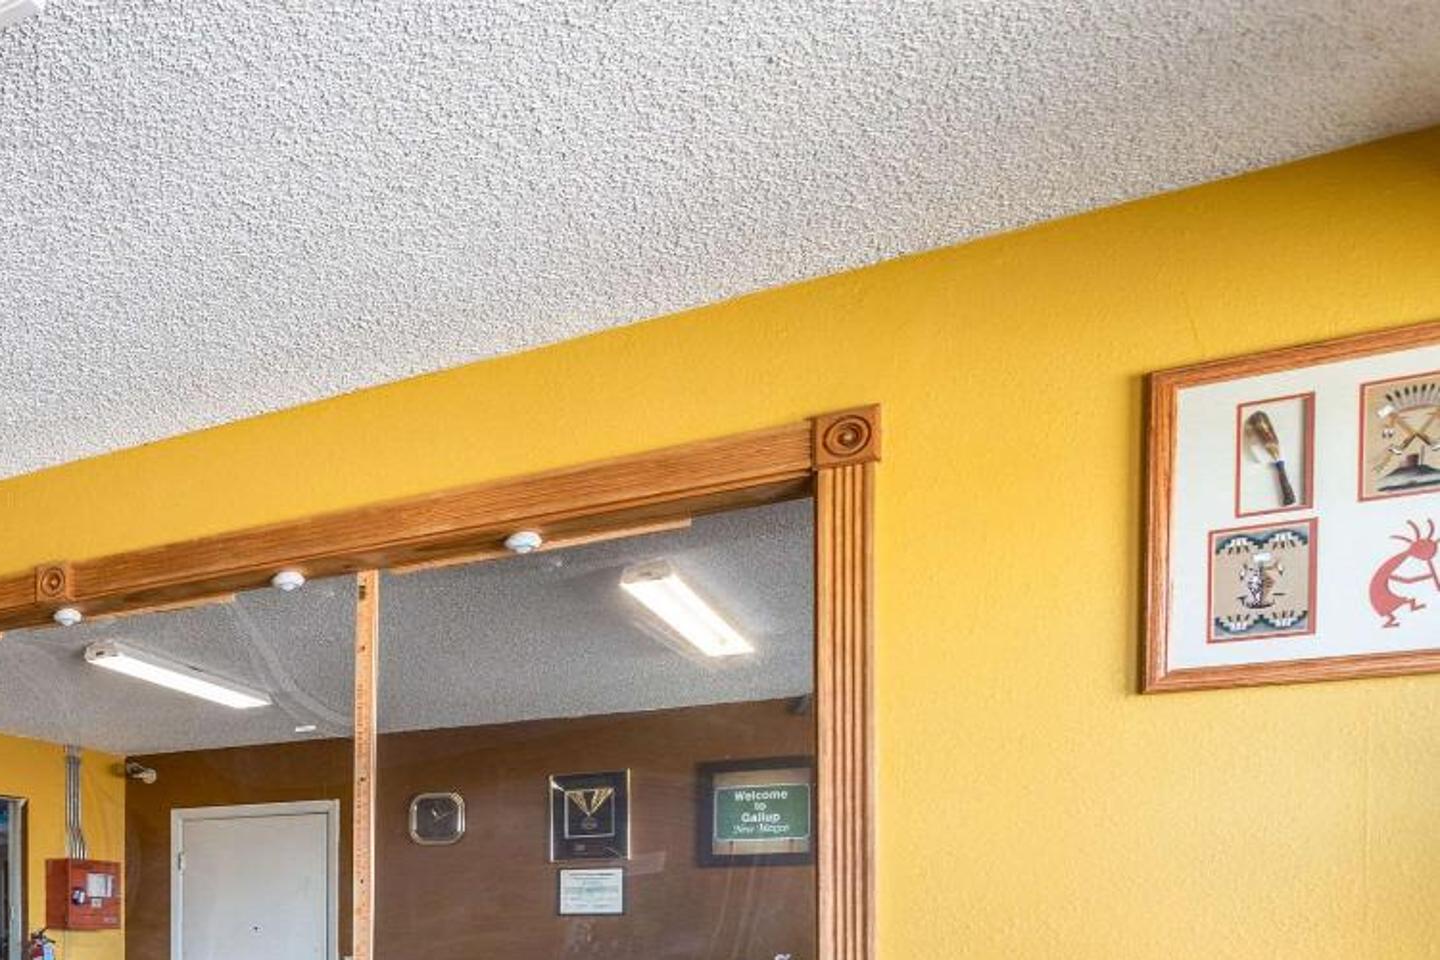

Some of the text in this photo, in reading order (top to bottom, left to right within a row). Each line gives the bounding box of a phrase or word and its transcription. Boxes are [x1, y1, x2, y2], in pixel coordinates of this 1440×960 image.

[735, 790, 788, 801] Welcome
[754, 802, 767, 811] to
[741, 812, 781, 823] Gallup
